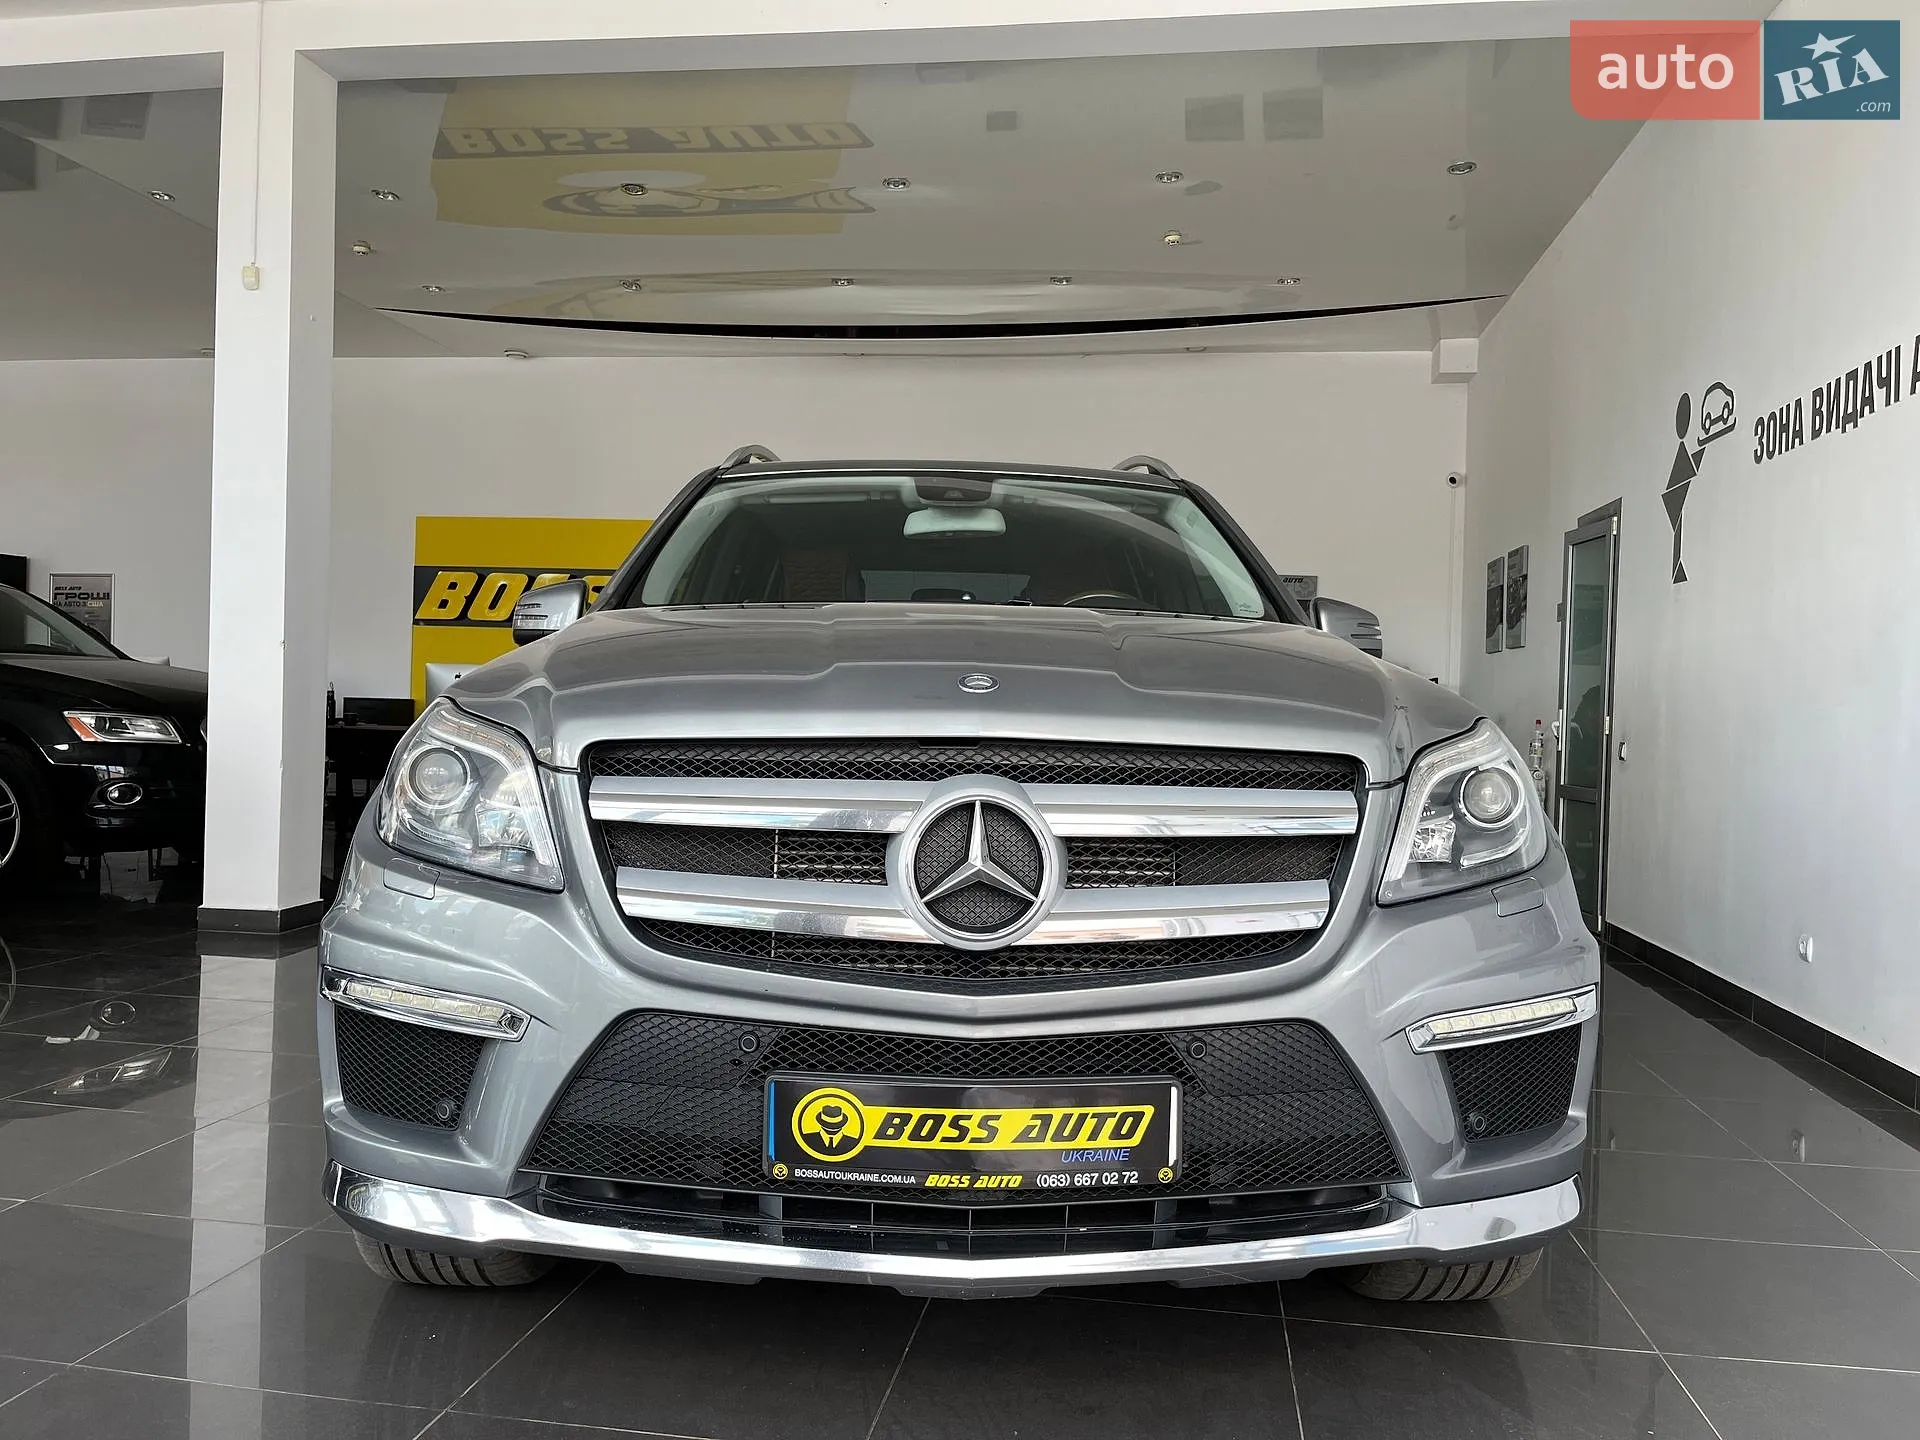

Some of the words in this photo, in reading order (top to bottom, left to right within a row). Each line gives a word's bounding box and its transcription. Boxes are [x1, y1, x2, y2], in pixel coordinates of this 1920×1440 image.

[1753, 397, 1804, 465] ЗОНА
[1811, 344, 1902, 441] ВИДАЧІ
[414, 571, 613, 620] BO
[872, 1112, 1003, 1144] BOSS
[1011, 1110, 1146, 1144] AUTO
[1061, 1148, 1131, 1163] UKRAINE
[794, 1168, 916, 1184] BOSSAUTOUKRAINE.COM.UA
[924, 1174, 971, 1188] BOSS
[973, 1175, 1023, 1188] AUTO
[1036, 1173, 1070, 1187] (063)
[1073, 1172, 1098, 1186] 667
[1101, 1172, 1121, 1185] 02
[1122, 1171, 1139, 1184] 72
